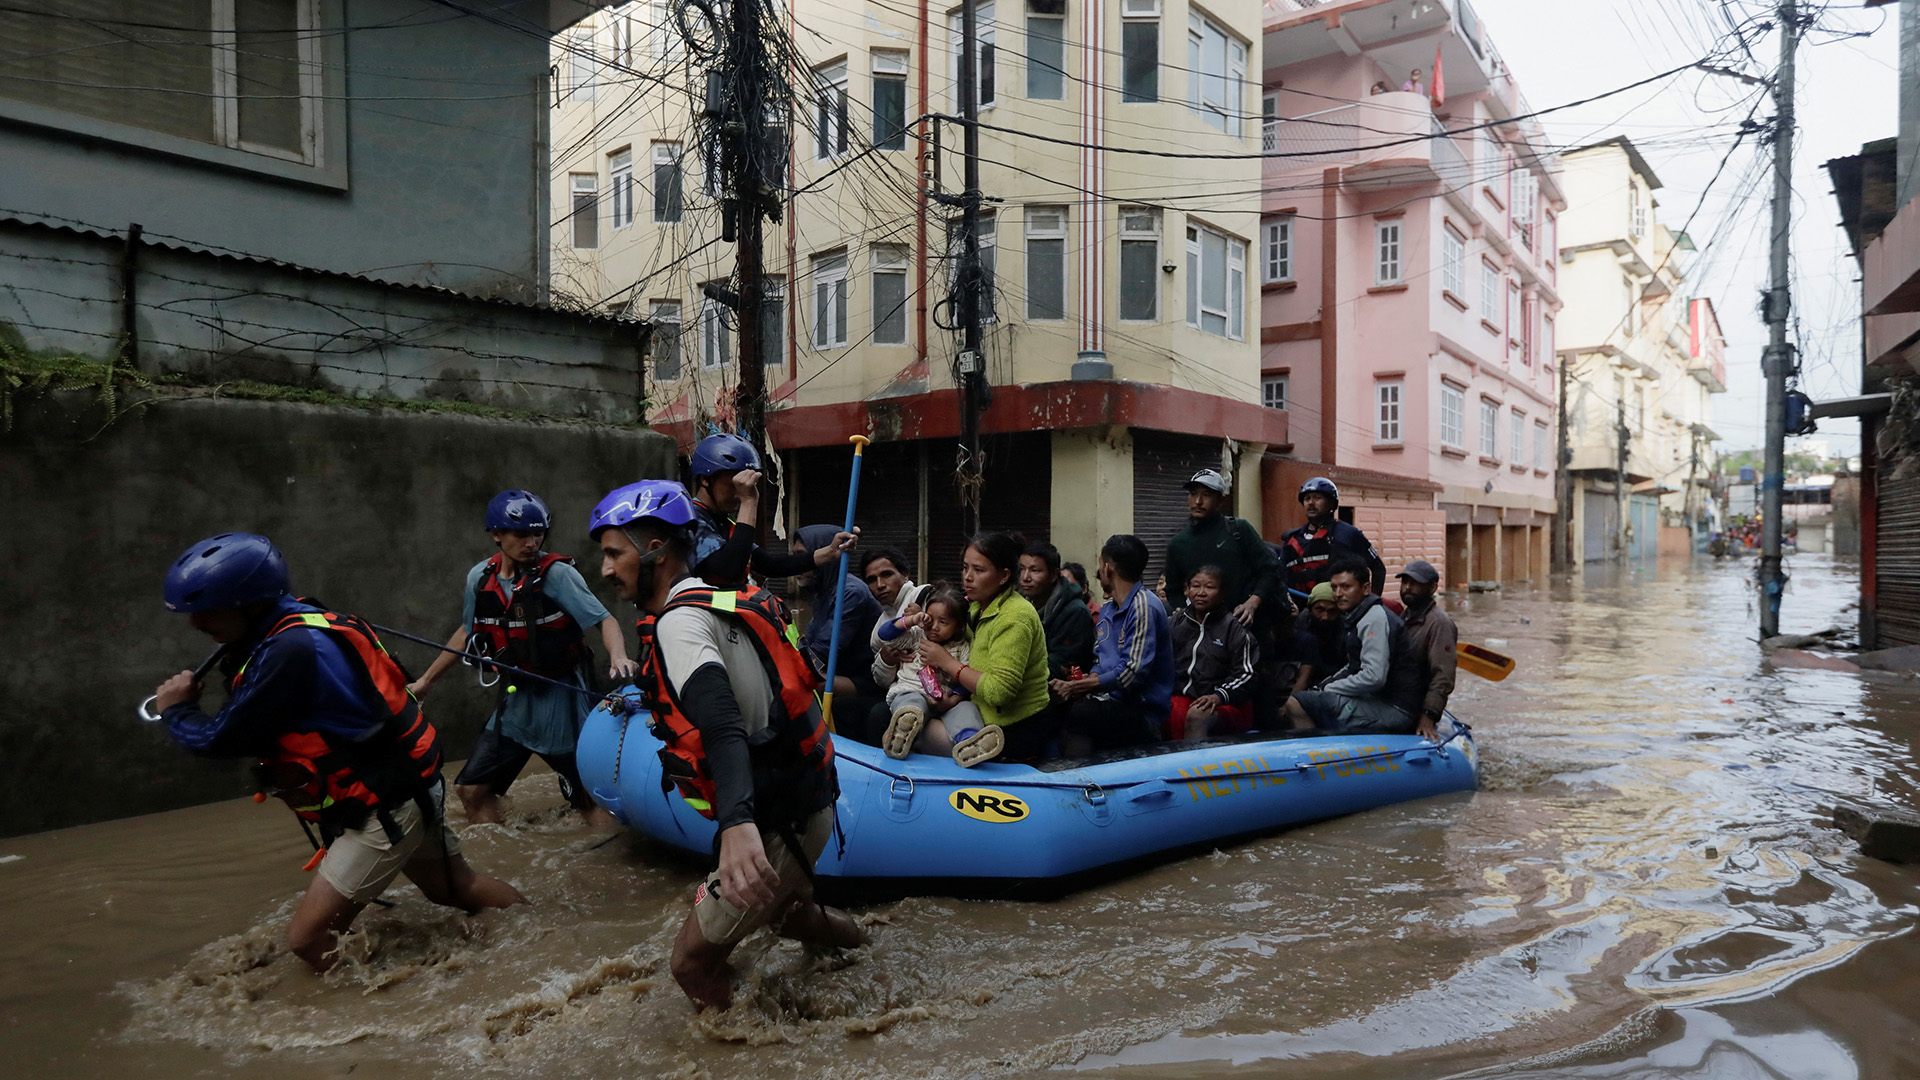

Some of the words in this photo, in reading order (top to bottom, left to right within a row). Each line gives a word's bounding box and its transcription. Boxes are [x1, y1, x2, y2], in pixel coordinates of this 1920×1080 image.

[1178, 757, 1286, 802] NEPAL
[1306, 746, 1400, 780] POLICE
[957, 792, 1024, 818] NRS
